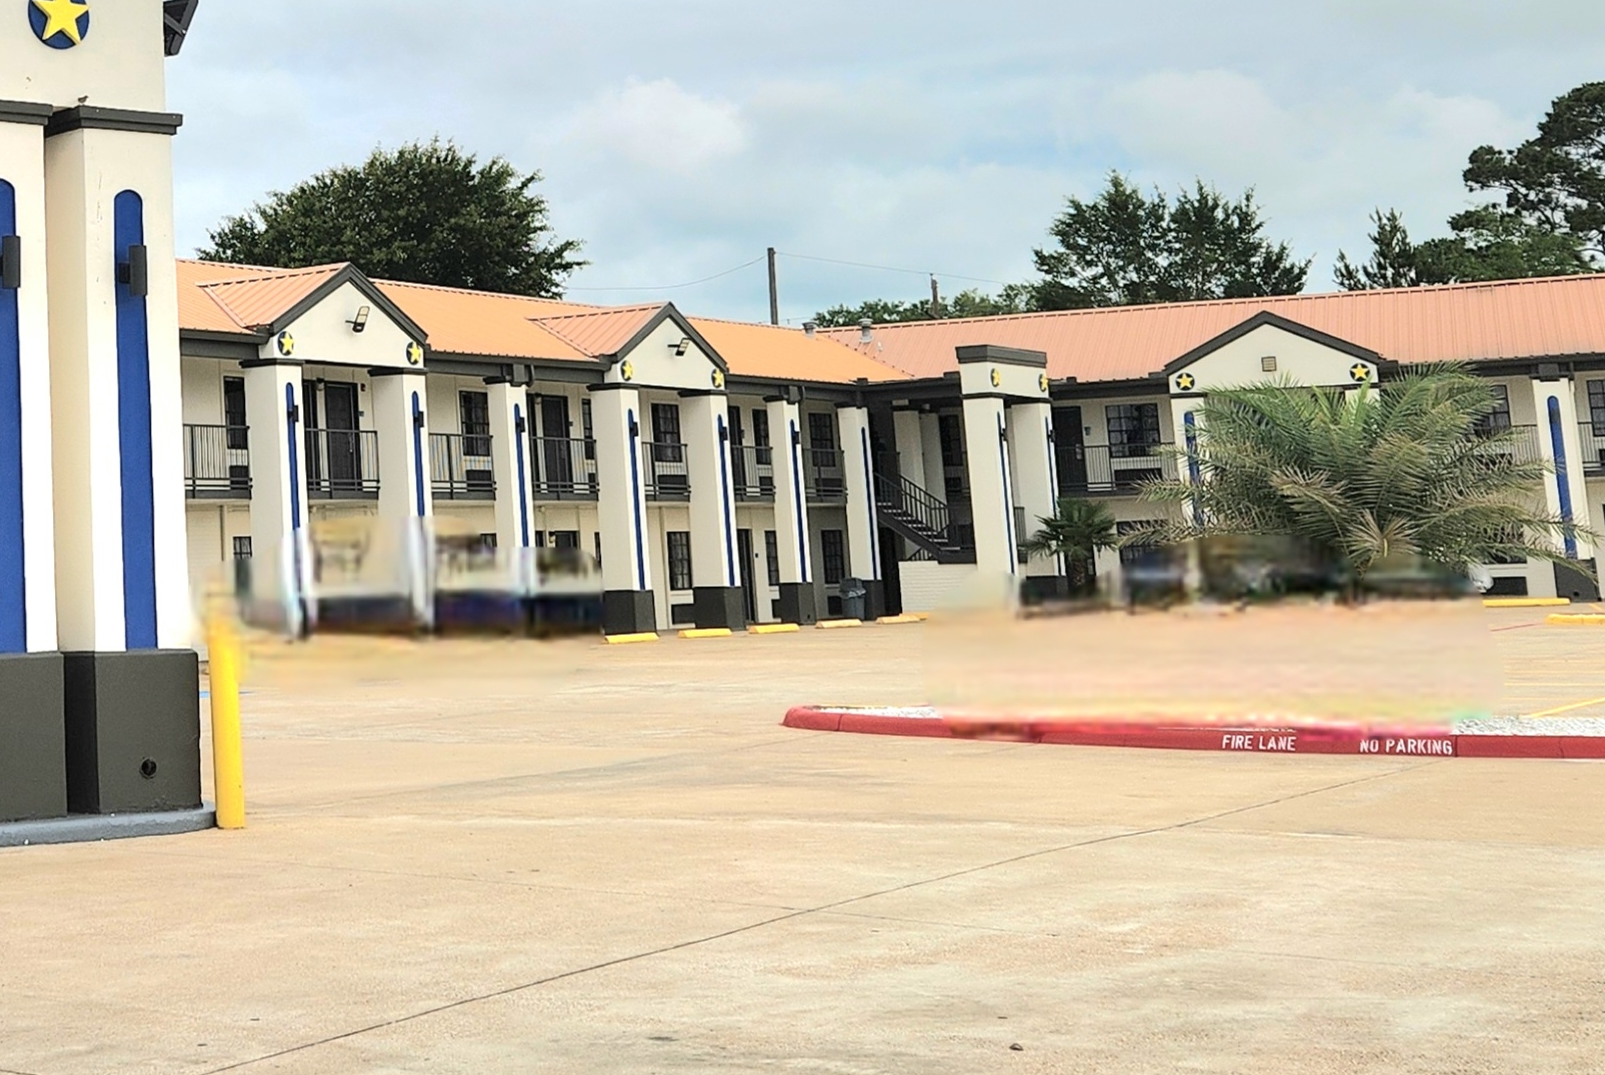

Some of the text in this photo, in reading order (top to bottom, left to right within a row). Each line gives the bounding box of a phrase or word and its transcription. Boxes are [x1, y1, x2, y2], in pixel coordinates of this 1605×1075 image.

[1222, 734, 1296, 751] FIRE LANE
[1359, 738, 1452, 755] NO PARKING
